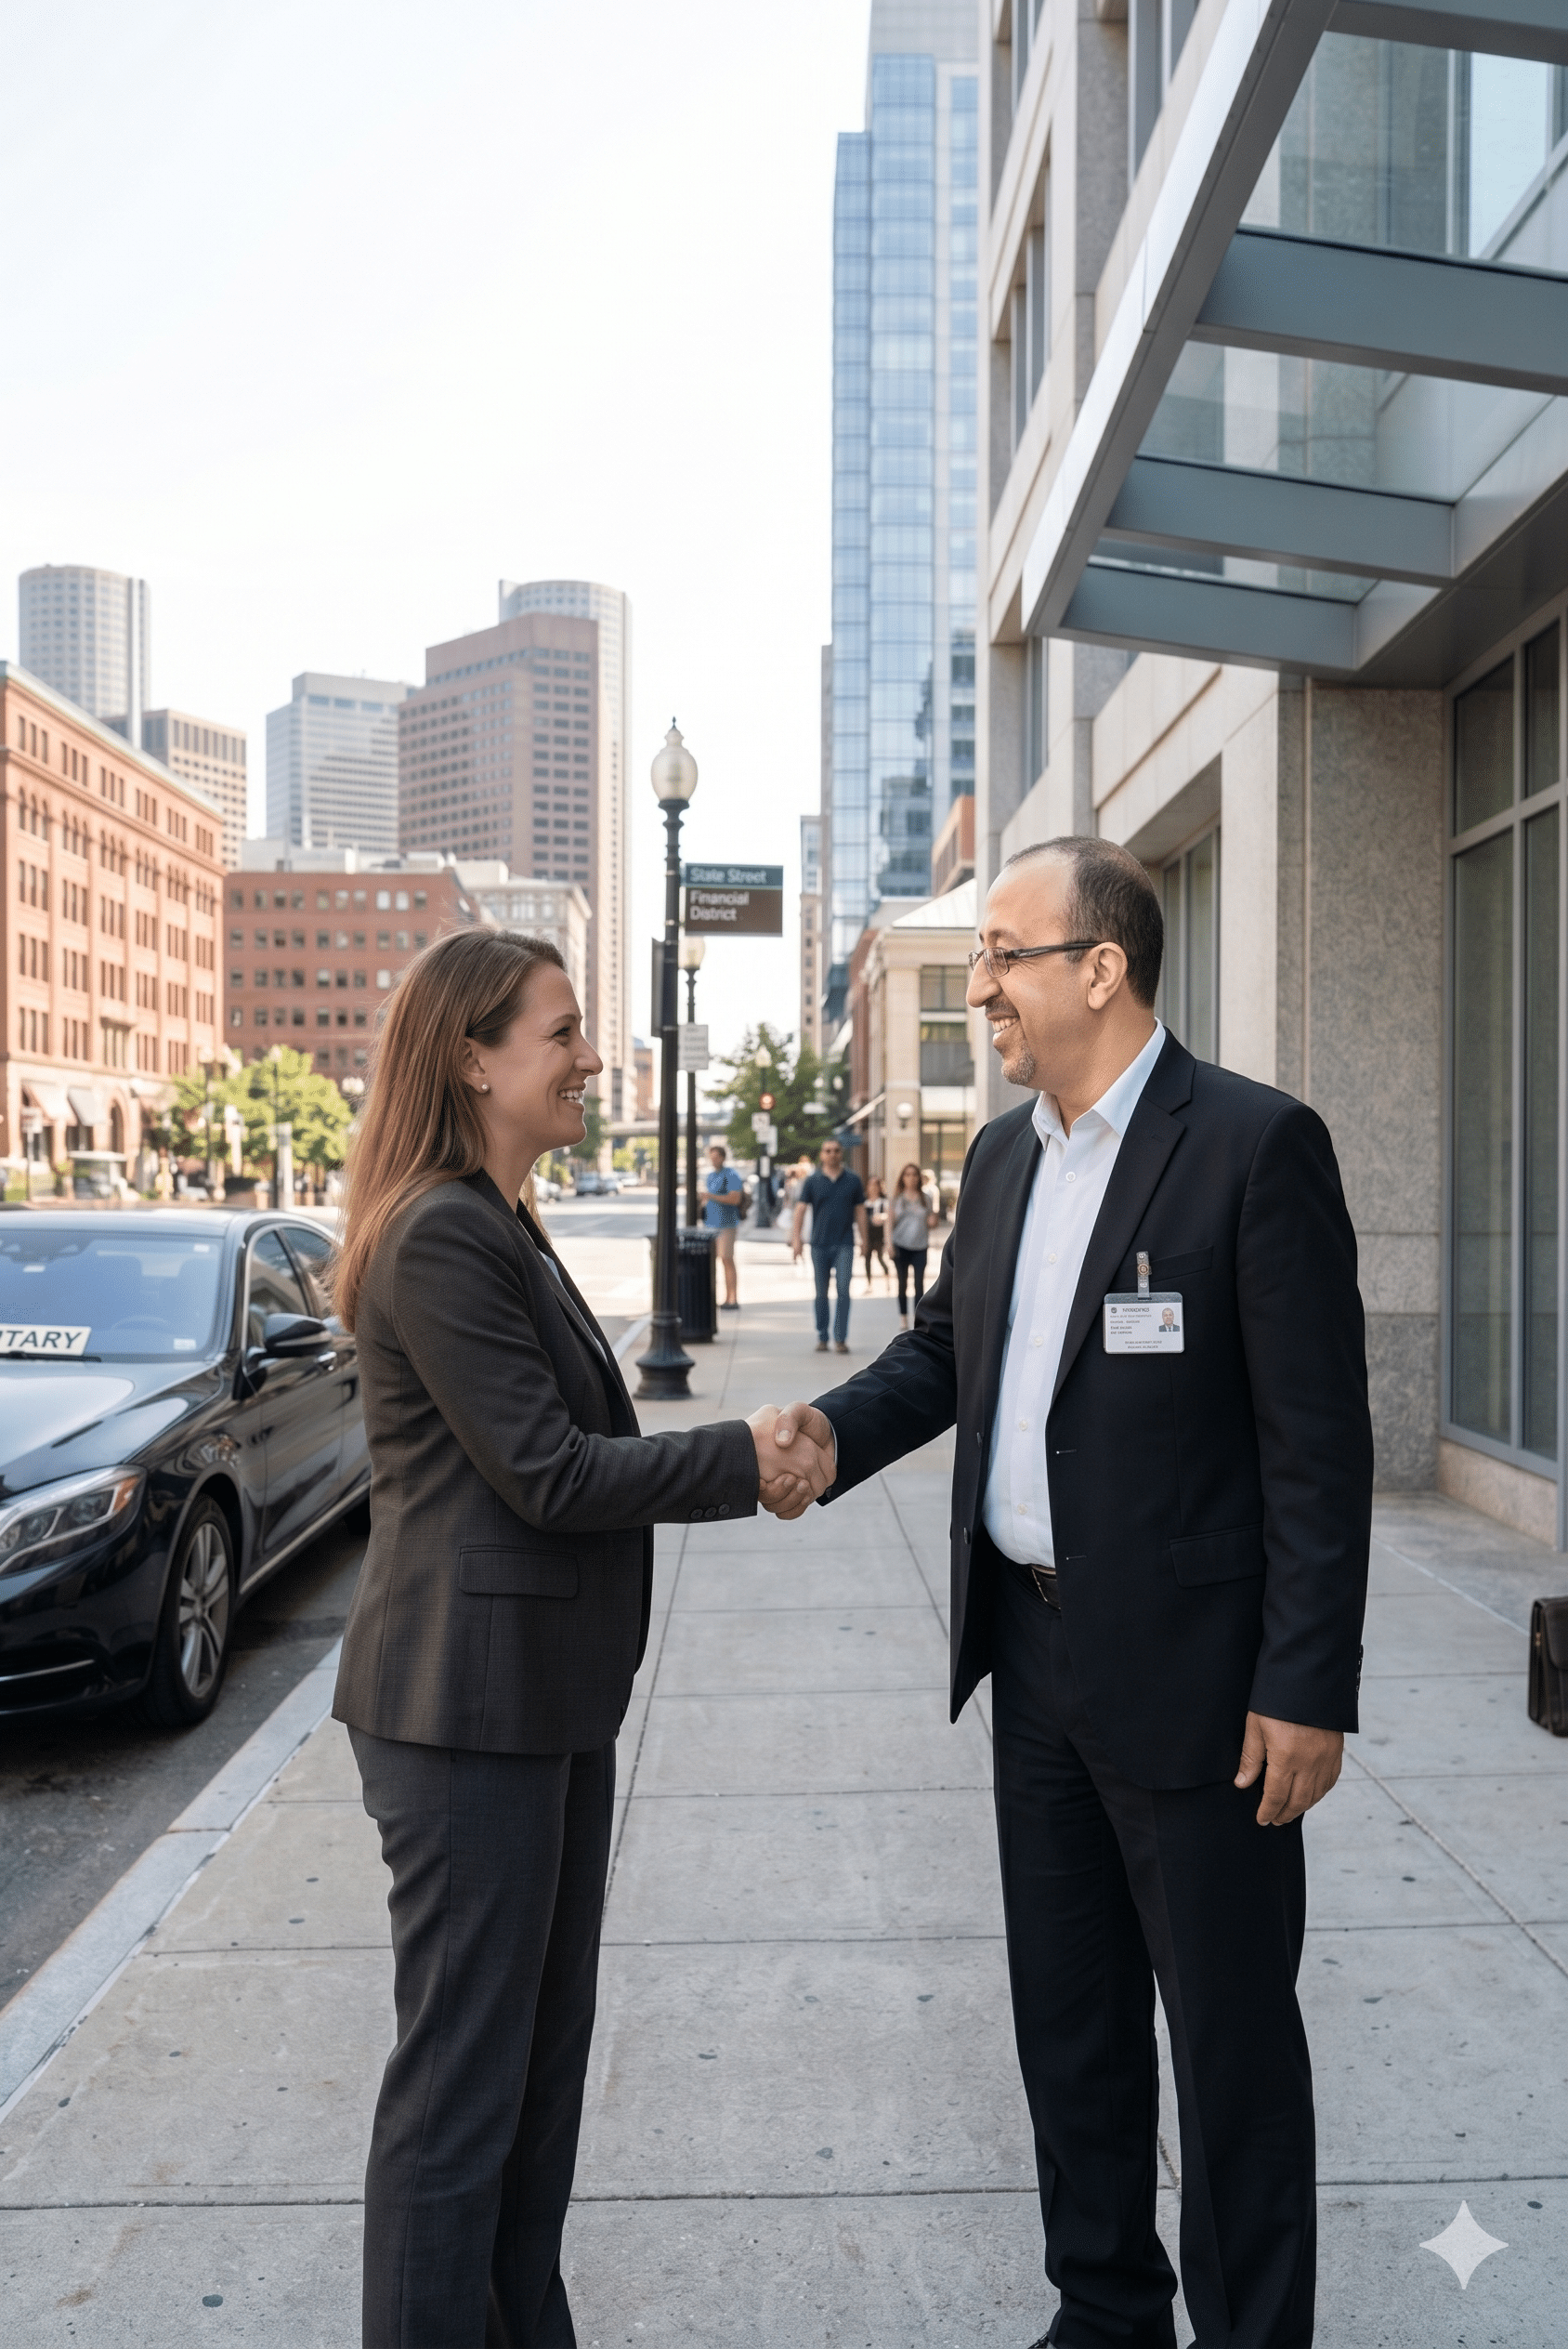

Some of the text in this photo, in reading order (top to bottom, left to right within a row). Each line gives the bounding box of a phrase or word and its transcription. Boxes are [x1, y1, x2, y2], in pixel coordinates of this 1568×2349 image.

[690, 867, 766, 884] State Street
[690, 890, 750, 905] Financial
[690, 905, 738, 922] District
[0, 1330, 82, 1349] TARY
